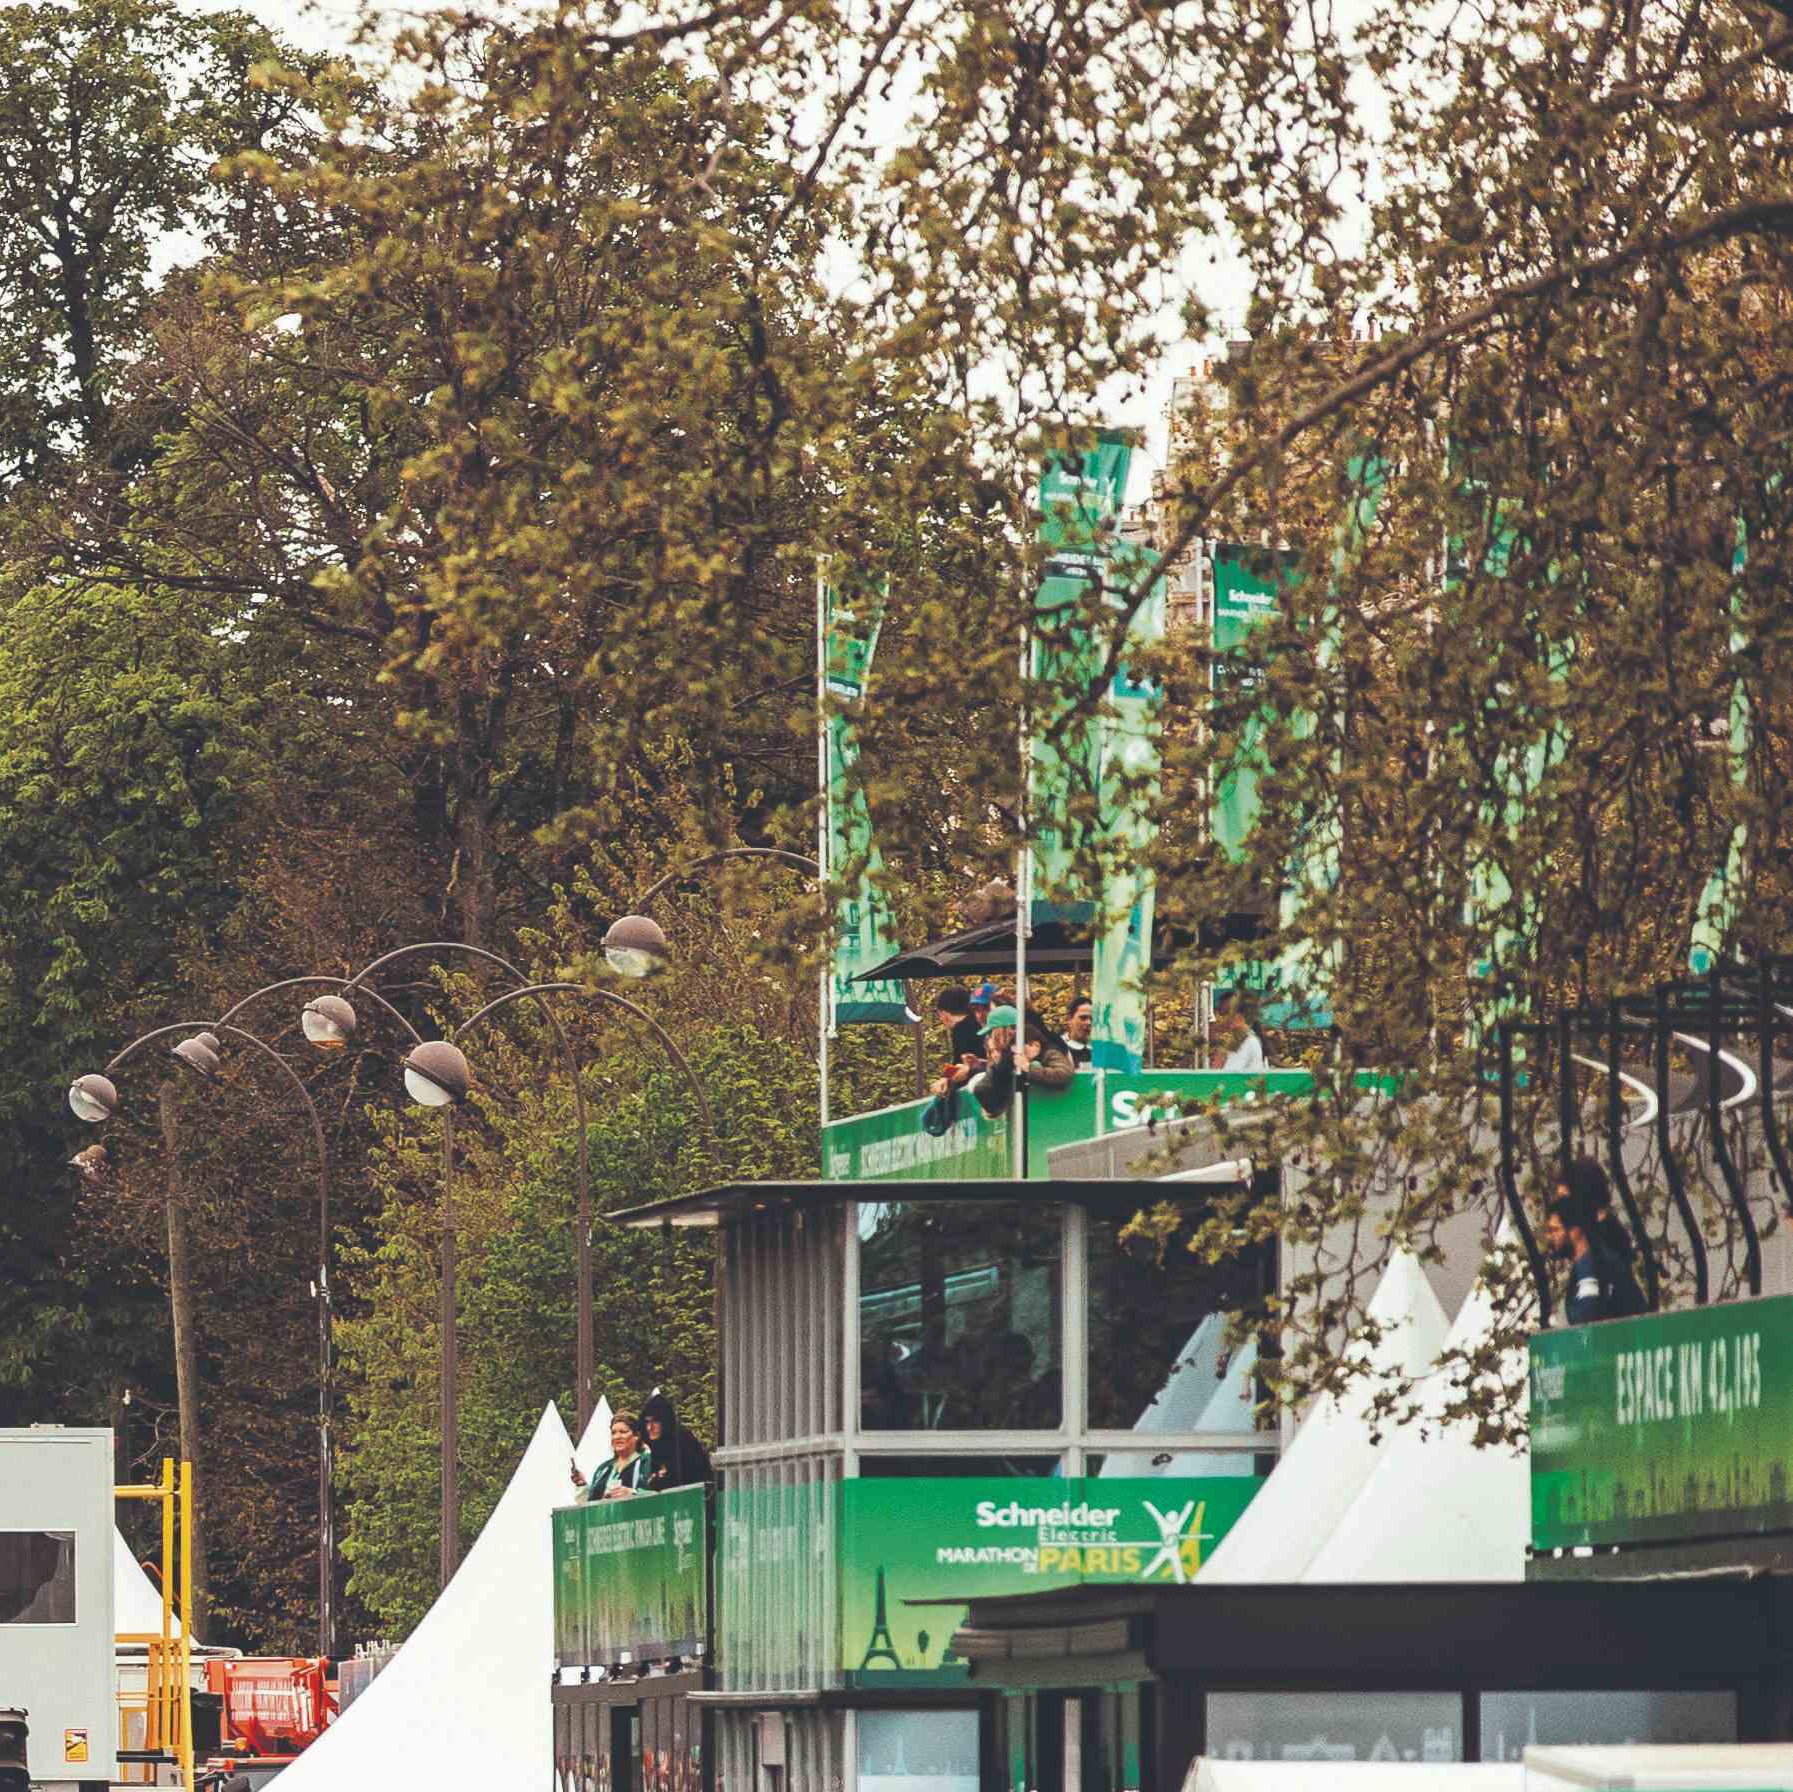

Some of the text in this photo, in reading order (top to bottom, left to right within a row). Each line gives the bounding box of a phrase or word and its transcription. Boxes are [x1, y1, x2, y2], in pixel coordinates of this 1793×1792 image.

[1617, 1345, 1674, 1425] ESPACE
[1679, 1341, 1703, 1417] KM
[976, 1501, 1120, 1527] Schneider
[1038, 1528, 1118, 1543] Electric
[936, 1547, 1141, 1574] MARATHON PARIS
